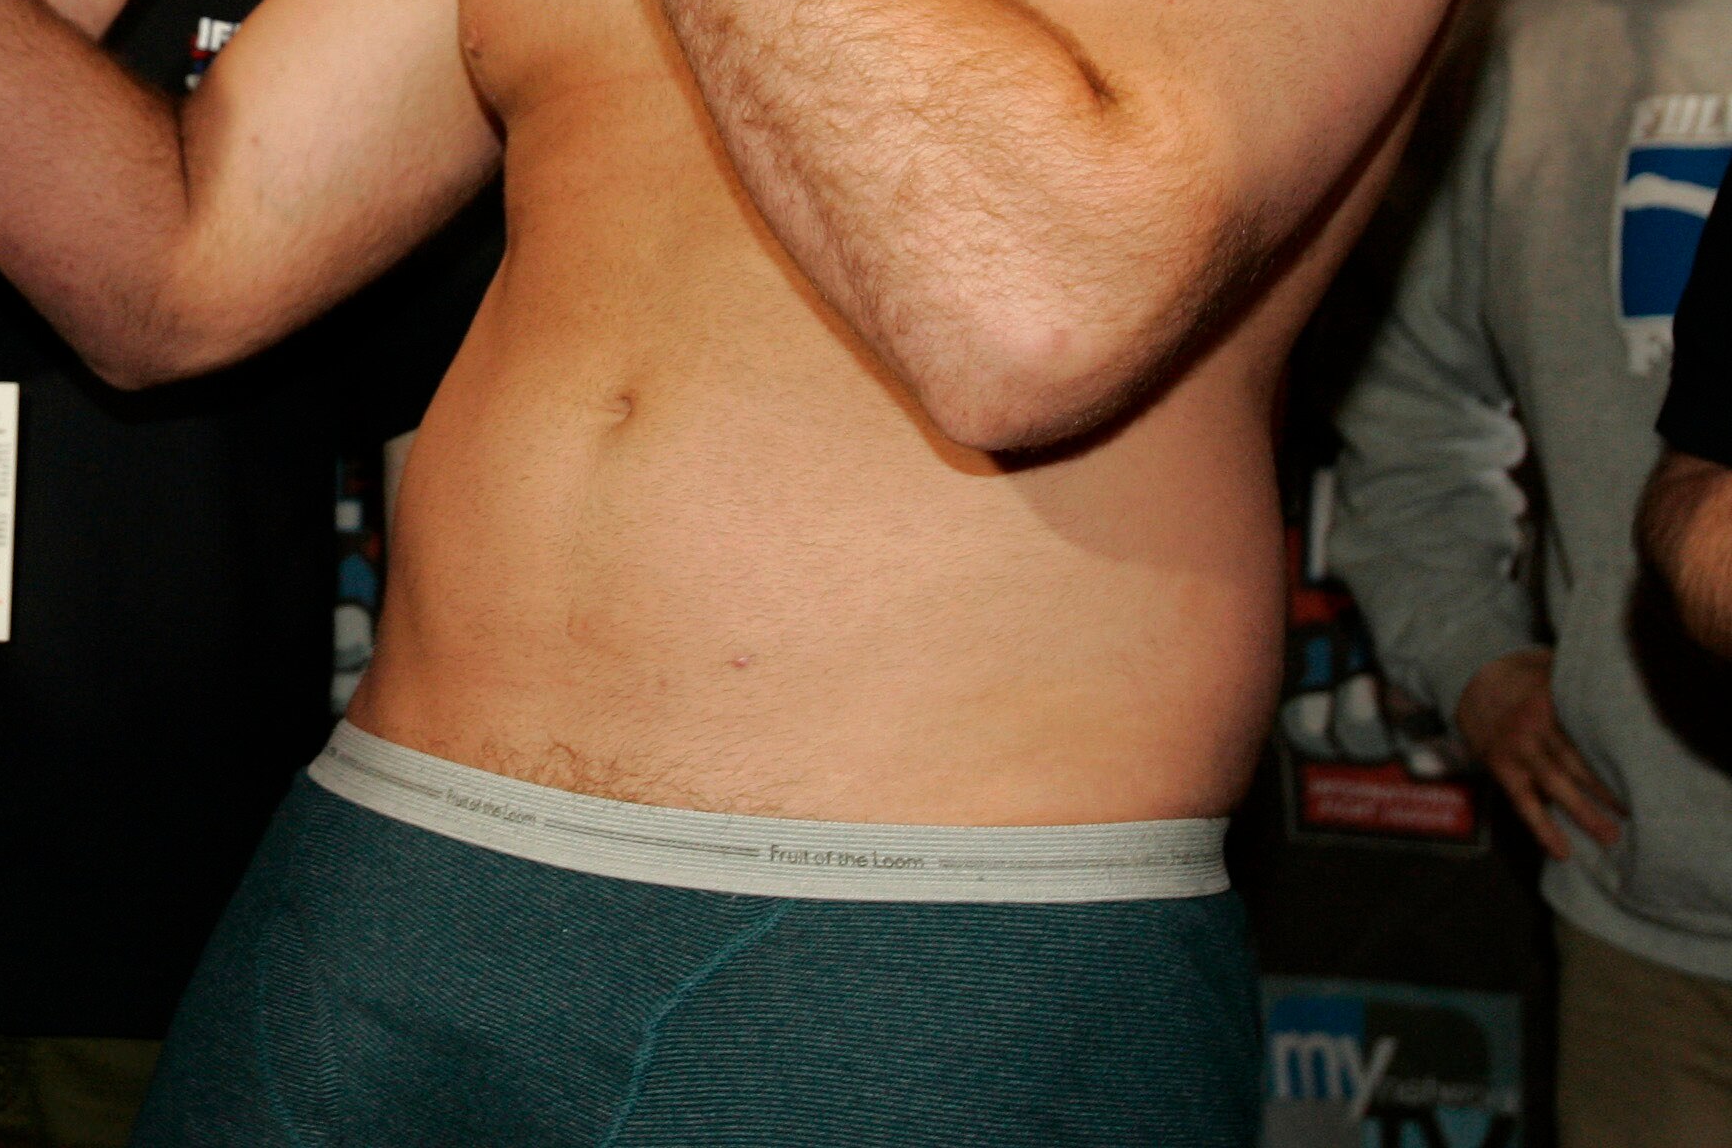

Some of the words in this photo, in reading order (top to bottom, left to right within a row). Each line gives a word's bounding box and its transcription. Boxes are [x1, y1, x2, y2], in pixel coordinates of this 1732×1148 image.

[196, 16, 242, 52] IF
[770, 843, 809, 865] Fruit
[815, 850, 834, 865] of
[838, 851, 868, 868] the
[872, 851, 924, 869] Loom
[1271, 1031, 1398, 1124] my
